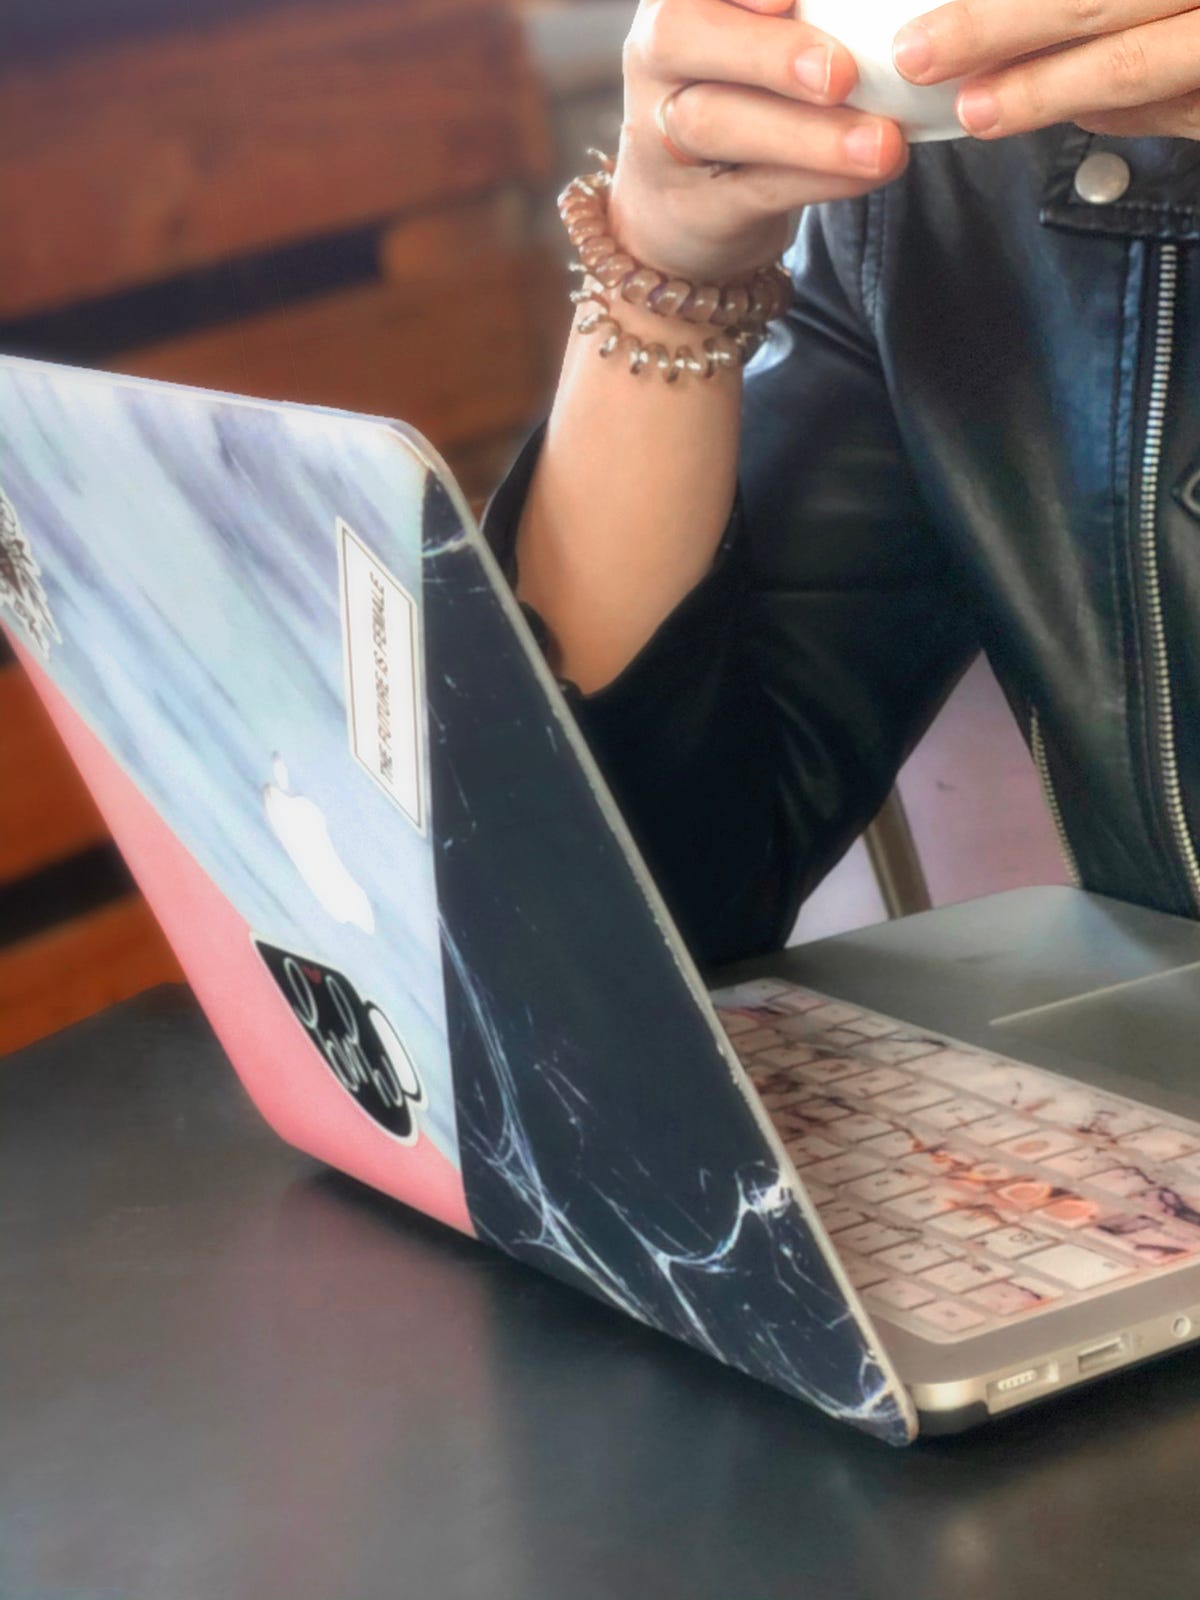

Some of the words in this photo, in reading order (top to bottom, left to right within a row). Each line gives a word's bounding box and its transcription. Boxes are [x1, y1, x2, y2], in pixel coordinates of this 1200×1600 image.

[370, 572, 386, 656] FEMALE
[374, 650, 388, 675] IS
[375, 671, 391, 750] FUTURE
[379, 744, 393, 784] THE
